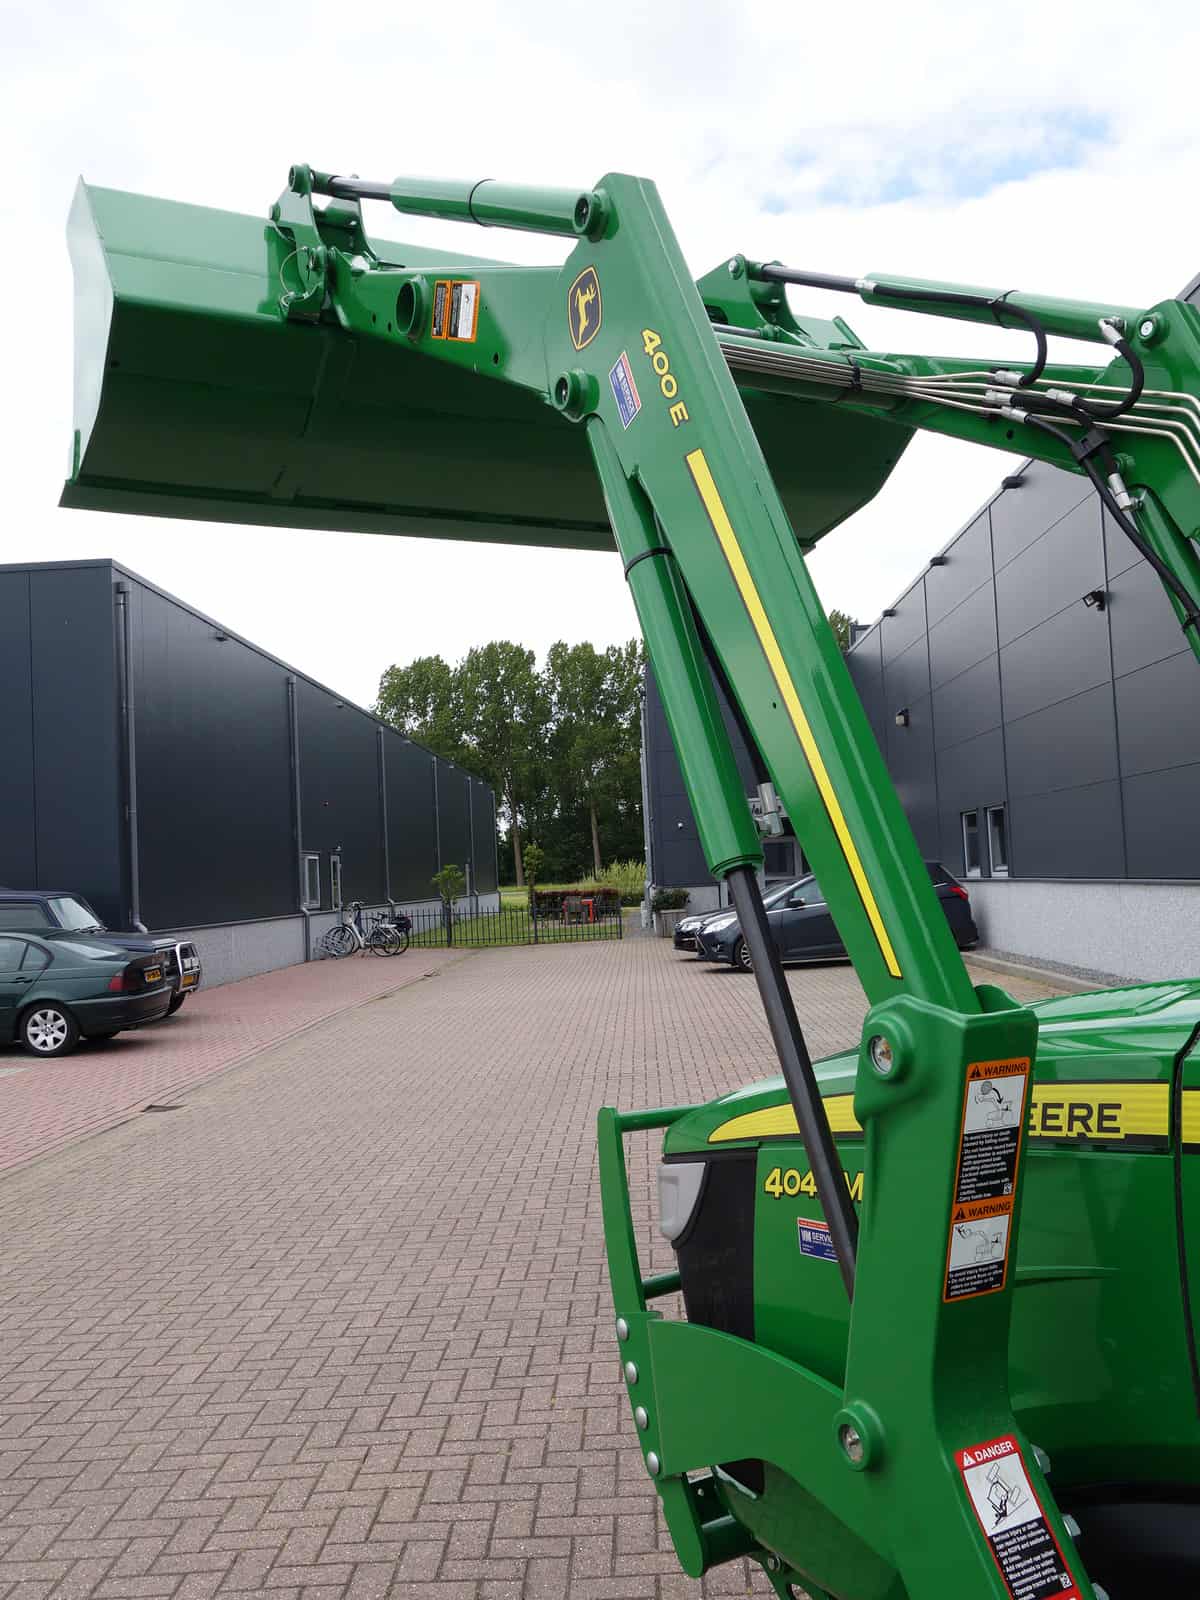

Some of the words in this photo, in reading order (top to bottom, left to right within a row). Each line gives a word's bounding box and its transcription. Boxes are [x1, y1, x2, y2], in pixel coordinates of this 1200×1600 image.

[984, 1062, 1027, 1077] WARNING
[763, 1166, 865, 1203] 404M
[968, 1201, 1011, 1217] WARNING
[974, 1440, 1015, 1462] DANGER
